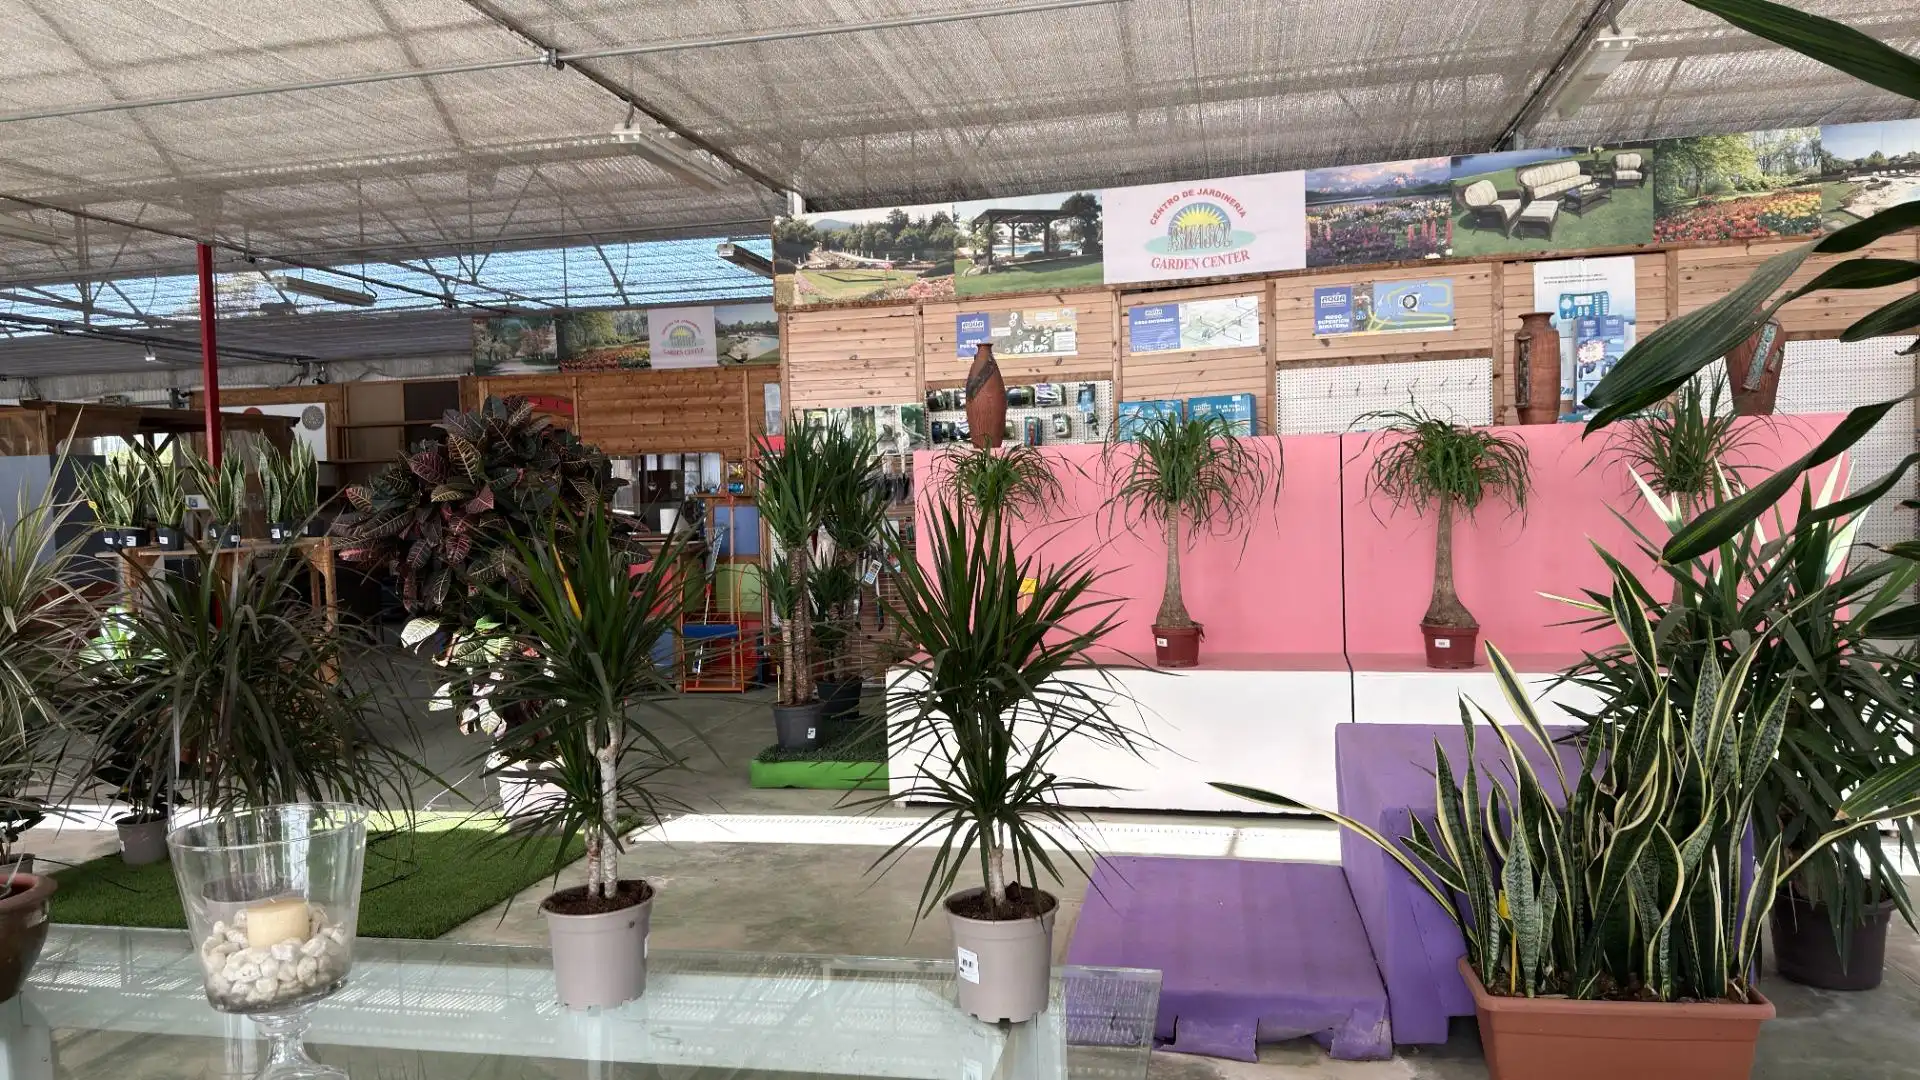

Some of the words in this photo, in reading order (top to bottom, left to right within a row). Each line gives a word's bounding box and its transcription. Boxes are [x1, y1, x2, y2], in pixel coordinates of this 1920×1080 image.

[1150, 195, 1180, 225] CENTRO
[1182, 189, 1195, 198] DE
[1151, 257, 1200, 270] GARDEN
[1202, 249, 1250, 268] CENTER
[1321, 295, 1346, 303] AQUA
